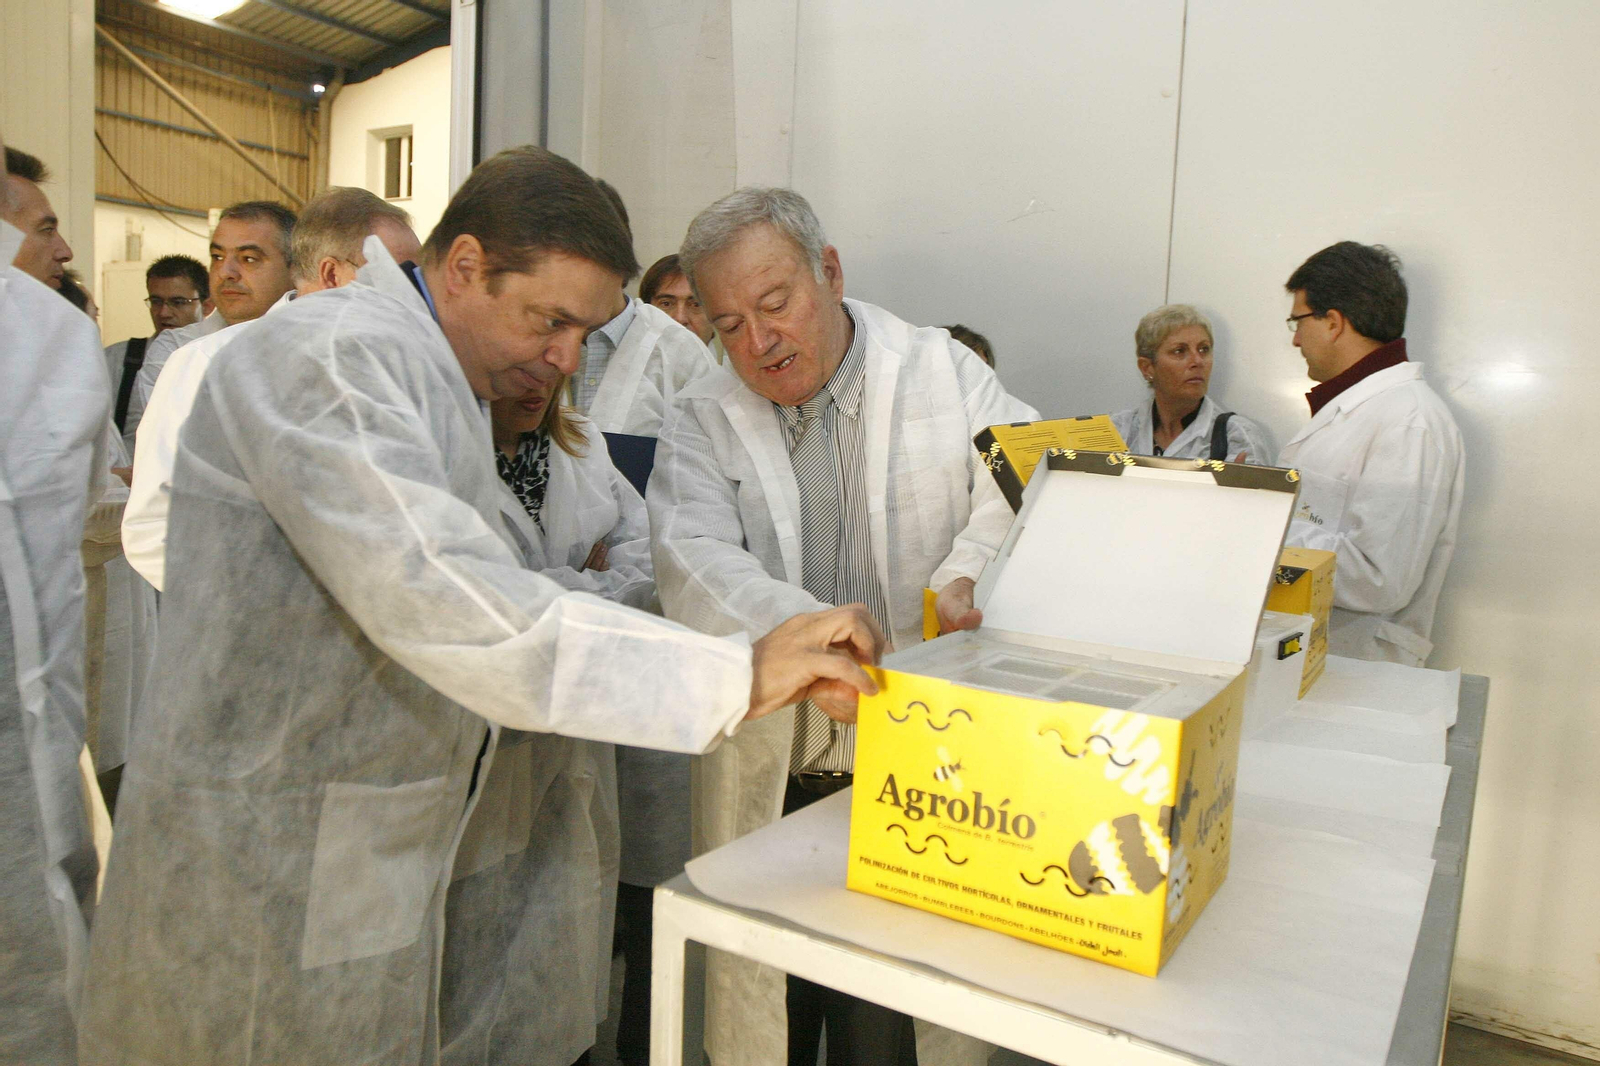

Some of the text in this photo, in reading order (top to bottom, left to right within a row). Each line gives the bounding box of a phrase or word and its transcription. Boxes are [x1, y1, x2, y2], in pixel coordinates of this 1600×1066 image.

[875, 773, 1036, 840] Agrobío
[859, 856, 909, 878] POLINIZACIÓN
[911, 871, 921, 880] DE
[922, 875, 960, 891] CULTIVOS
[961, 886, 1013, 908] HORTÍCOLAS,
[1016, 900, 1086, 926] ORNAMENTALES
[1088, 919, 1095, 929] Y
[1096, 922, 1143, 941] FRUTALES
